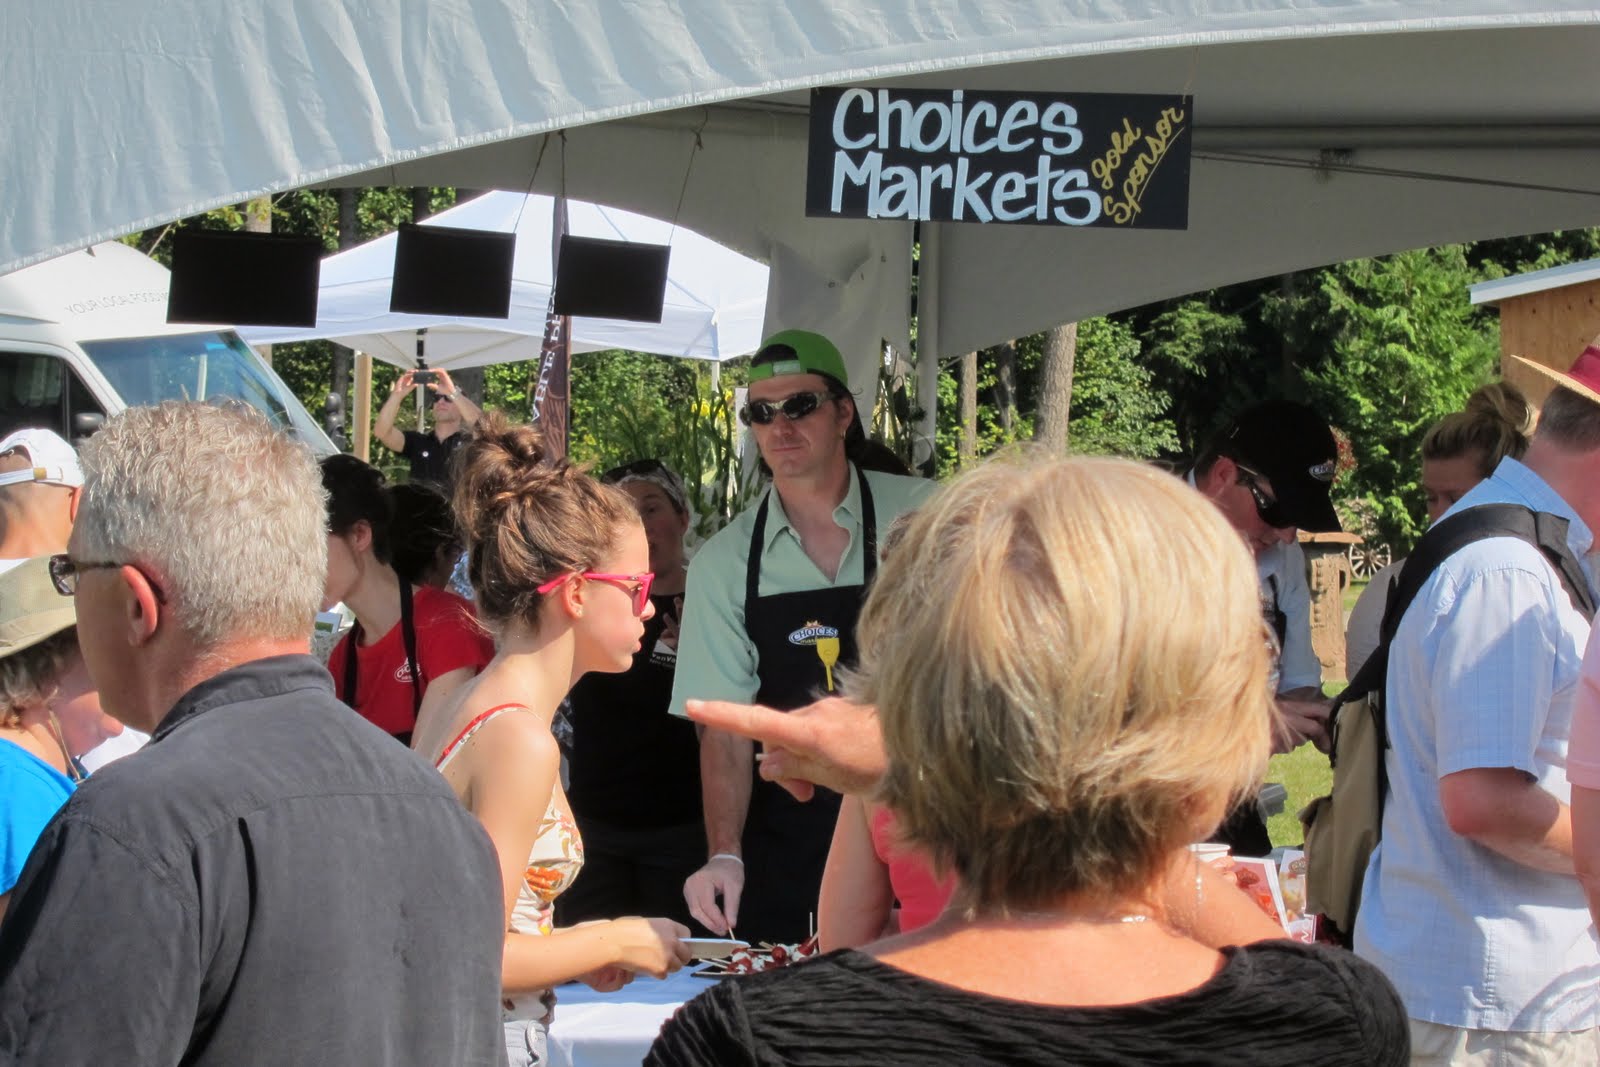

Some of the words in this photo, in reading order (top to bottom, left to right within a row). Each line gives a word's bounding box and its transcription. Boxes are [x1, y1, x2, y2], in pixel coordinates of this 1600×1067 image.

[832, 88, 1083, 155] Choices
[831, 150, 1101, 226] Markets
[792, 627, 837, 641] CHOICES
